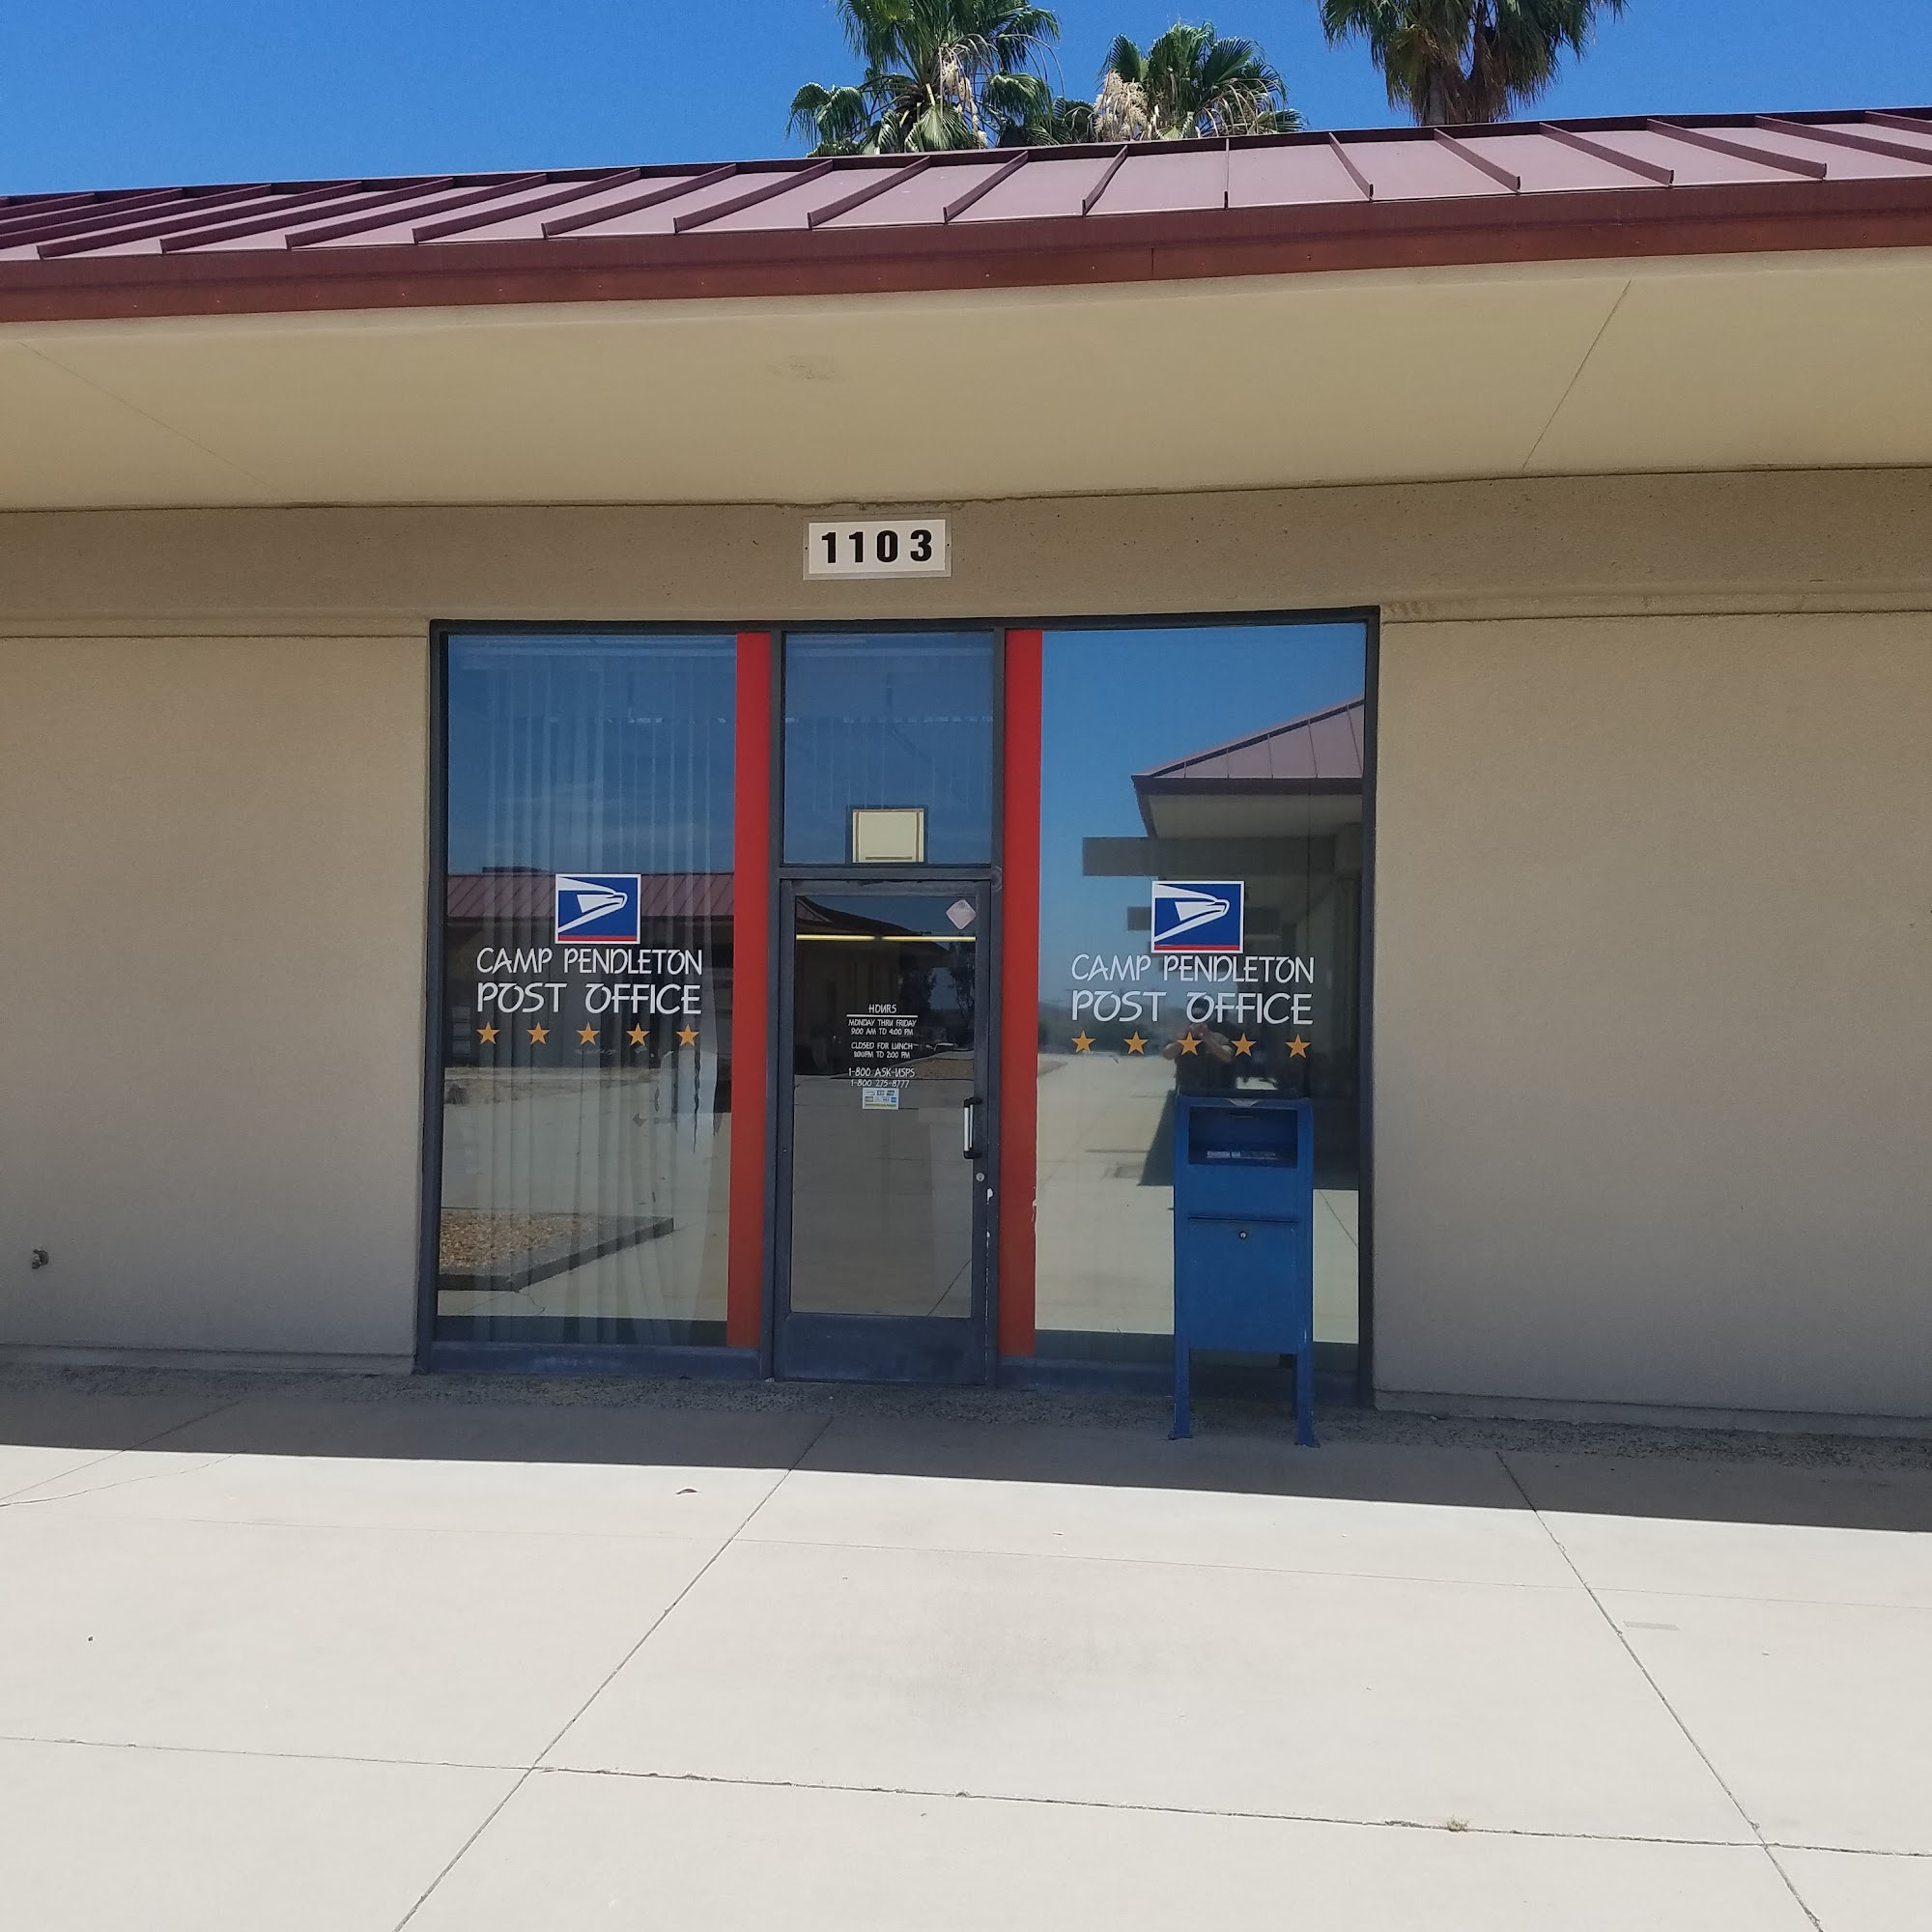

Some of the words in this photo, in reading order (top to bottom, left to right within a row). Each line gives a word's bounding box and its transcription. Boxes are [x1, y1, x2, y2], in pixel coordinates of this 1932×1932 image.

[821, 529, 932, 563] 1103
[476, 947, 553, 974] CAMP
[564, 948, 702, 976] PENDLETON
[1071, 953, 1151, 982] CAMP
[1163, 954, 1314, 983] PENDLETON
[477, 982, 567, 1013] POST
[585, 983, 701, 1014] OFFICE
[868, 1004, 897, 1013] HOURS
[1071, 989, 1166, 1022] POST
[1186, 992, 1313, 1025] OFFICE
[848, 1066, 871, 1077] 1-800
[874, 1067, 915, 1078] ASK-USPS
